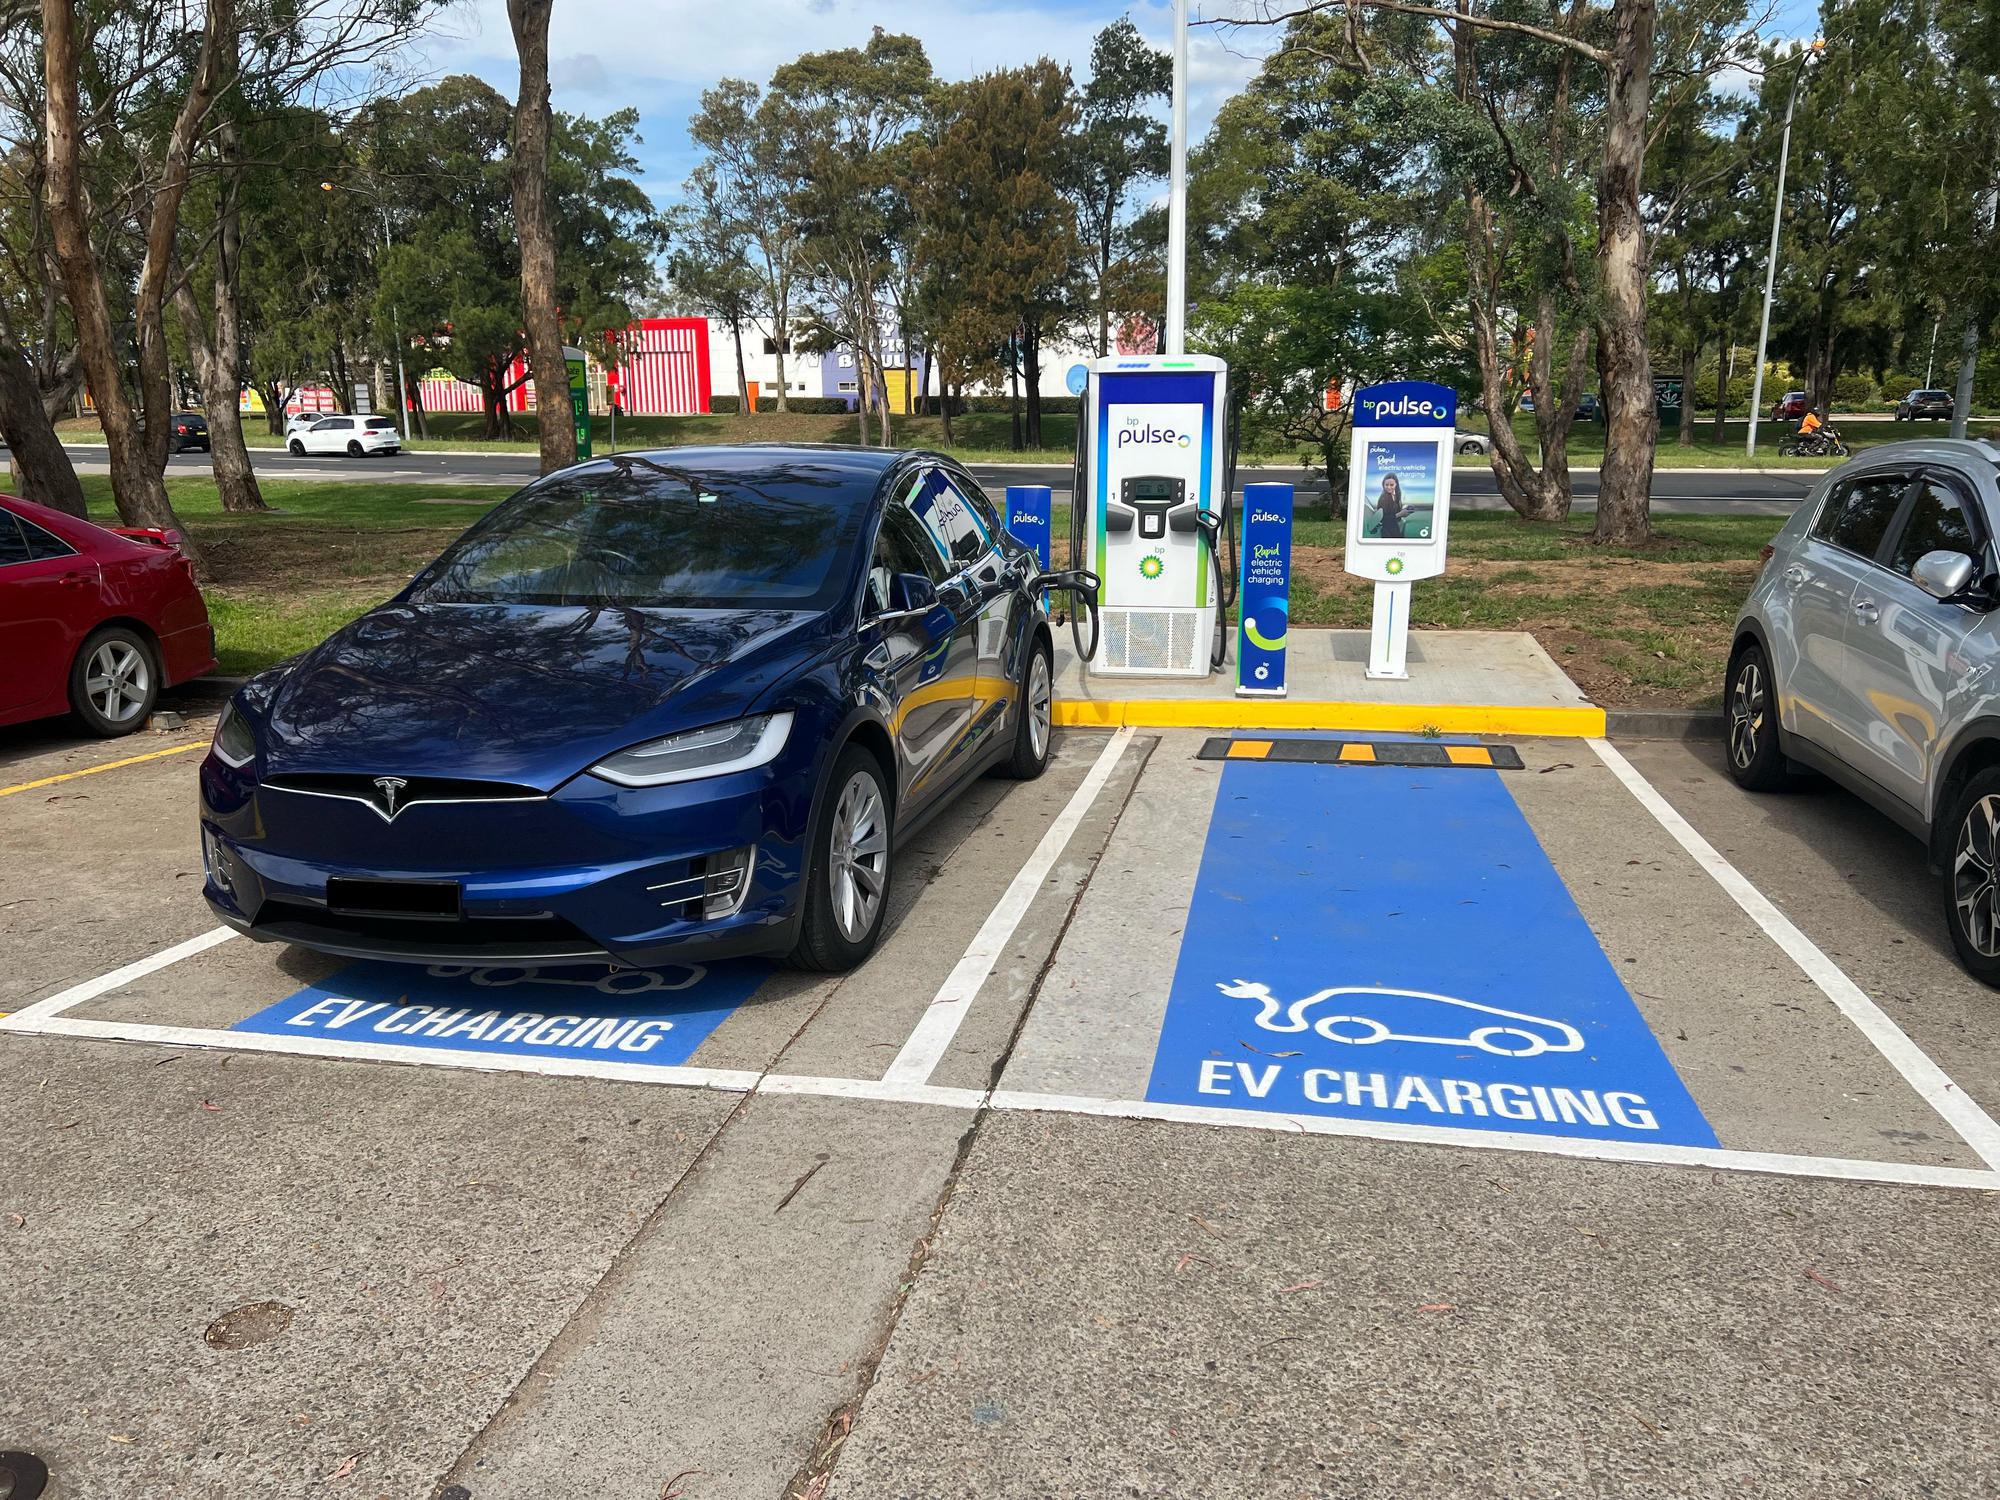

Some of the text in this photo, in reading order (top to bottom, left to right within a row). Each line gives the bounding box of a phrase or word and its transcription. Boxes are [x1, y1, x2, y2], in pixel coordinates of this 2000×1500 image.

[1363, 395, 1432, 420] bp pulse
[1126, 416, 1139, 427] bp
[1118, 423, 1176, 448] pulse
[1369, 446, 1387, 454] pulse
[1397, 471, 1425, 479] charging
[1111, 492, 1116, 500] 1
[1189, 492, 1195, 500] 2
[1013, 513, 1038, 525] pulse
[1251, 512, 1279, 524] pulse
[1154, 546, 1165, 555] bp
[1253, 543, 1280, 559] Rapid
[1251, 558, 1283, 567] electric
[1251, 567, 1282, 576] vehicle
[1247, 575, 1285, 586] charging
[286, 998, 673, 1052] EV CHARGING
[1198, 1059, 1660, 1130] EV CHARGING
